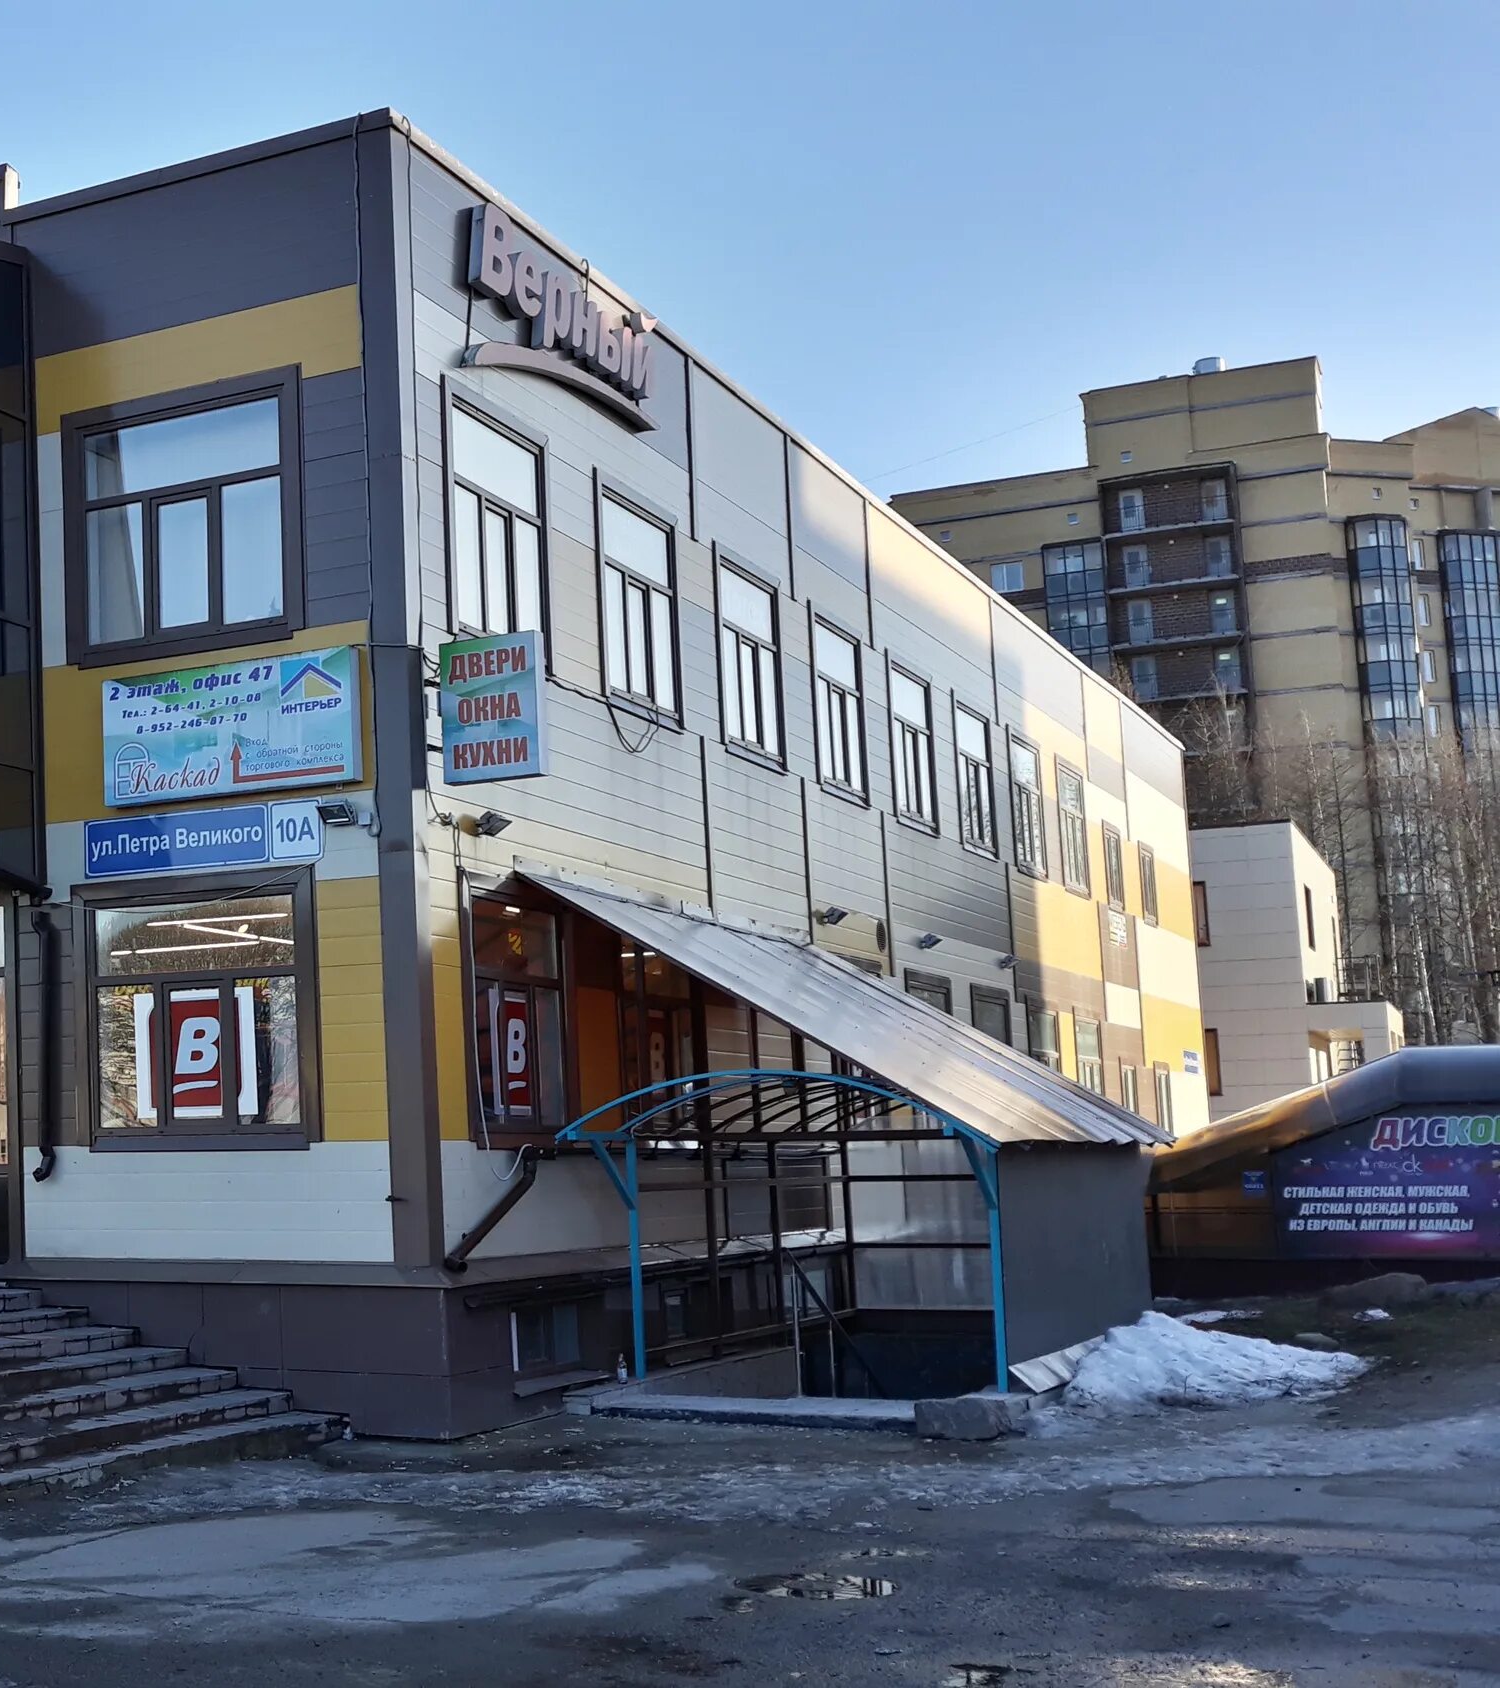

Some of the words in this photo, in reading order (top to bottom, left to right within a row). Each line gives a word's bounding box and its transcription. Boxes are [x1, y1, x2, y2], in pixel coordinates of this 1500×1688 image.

[472, 202, 657, 395] Верный
[449, 645, 526, 685] ДВЕРИ
[109, 687, 120, 701] 2
[127, 679, 187, 699] этаж,
[192, 673, 242, 691] офис
[248, 665, 273, 682] 47
[122, 709, 147, 719] Тел.:
[209, 692, 261, 708] 2-10-08
[281, 698, 342, 715] ИНТЕРЬЕР
[457, 692, 521, 724] ОКНА
[136, 712, 248, 735] 8-952-246-87-70
[245, 738, 268, 747] Вход
[256, 745, 299, 759] обратной
[304, 742, 343, 753] стороны
[453, 736, 528, 770] КУХНИ
[130, 757, 221, 794] Каскад
[245, 760, 290, 773] торгового
[296, 754, 344, 767] комплекса
[91, 834, 170, 862] ул.Петра
[175, 825, 263, 849] Великого
[275, 816, 315, 844] 10А
[1370, 1116, 1500, 1151] ДИСКО
[1283, 1186, 1345, 1199] СТИЛЬНАЯ
[1299, 1203, 1353, 1216] ДЕТСКАЯ
[1355, 1203, 1406, 1216] ОДЕЖДА
[1408, 1203, 1417, 1214] И
[1419, 1202, 1459, 1214] ОБУВЬ
[1289, 1220, 1305, 1231] ИЗ
[1359, 1219, 1407, 1231] АНГЛИИ
[1408, 1219, 1417, 1231] И
[1419, 1219, 1474, 1232] КАНАДЫ
